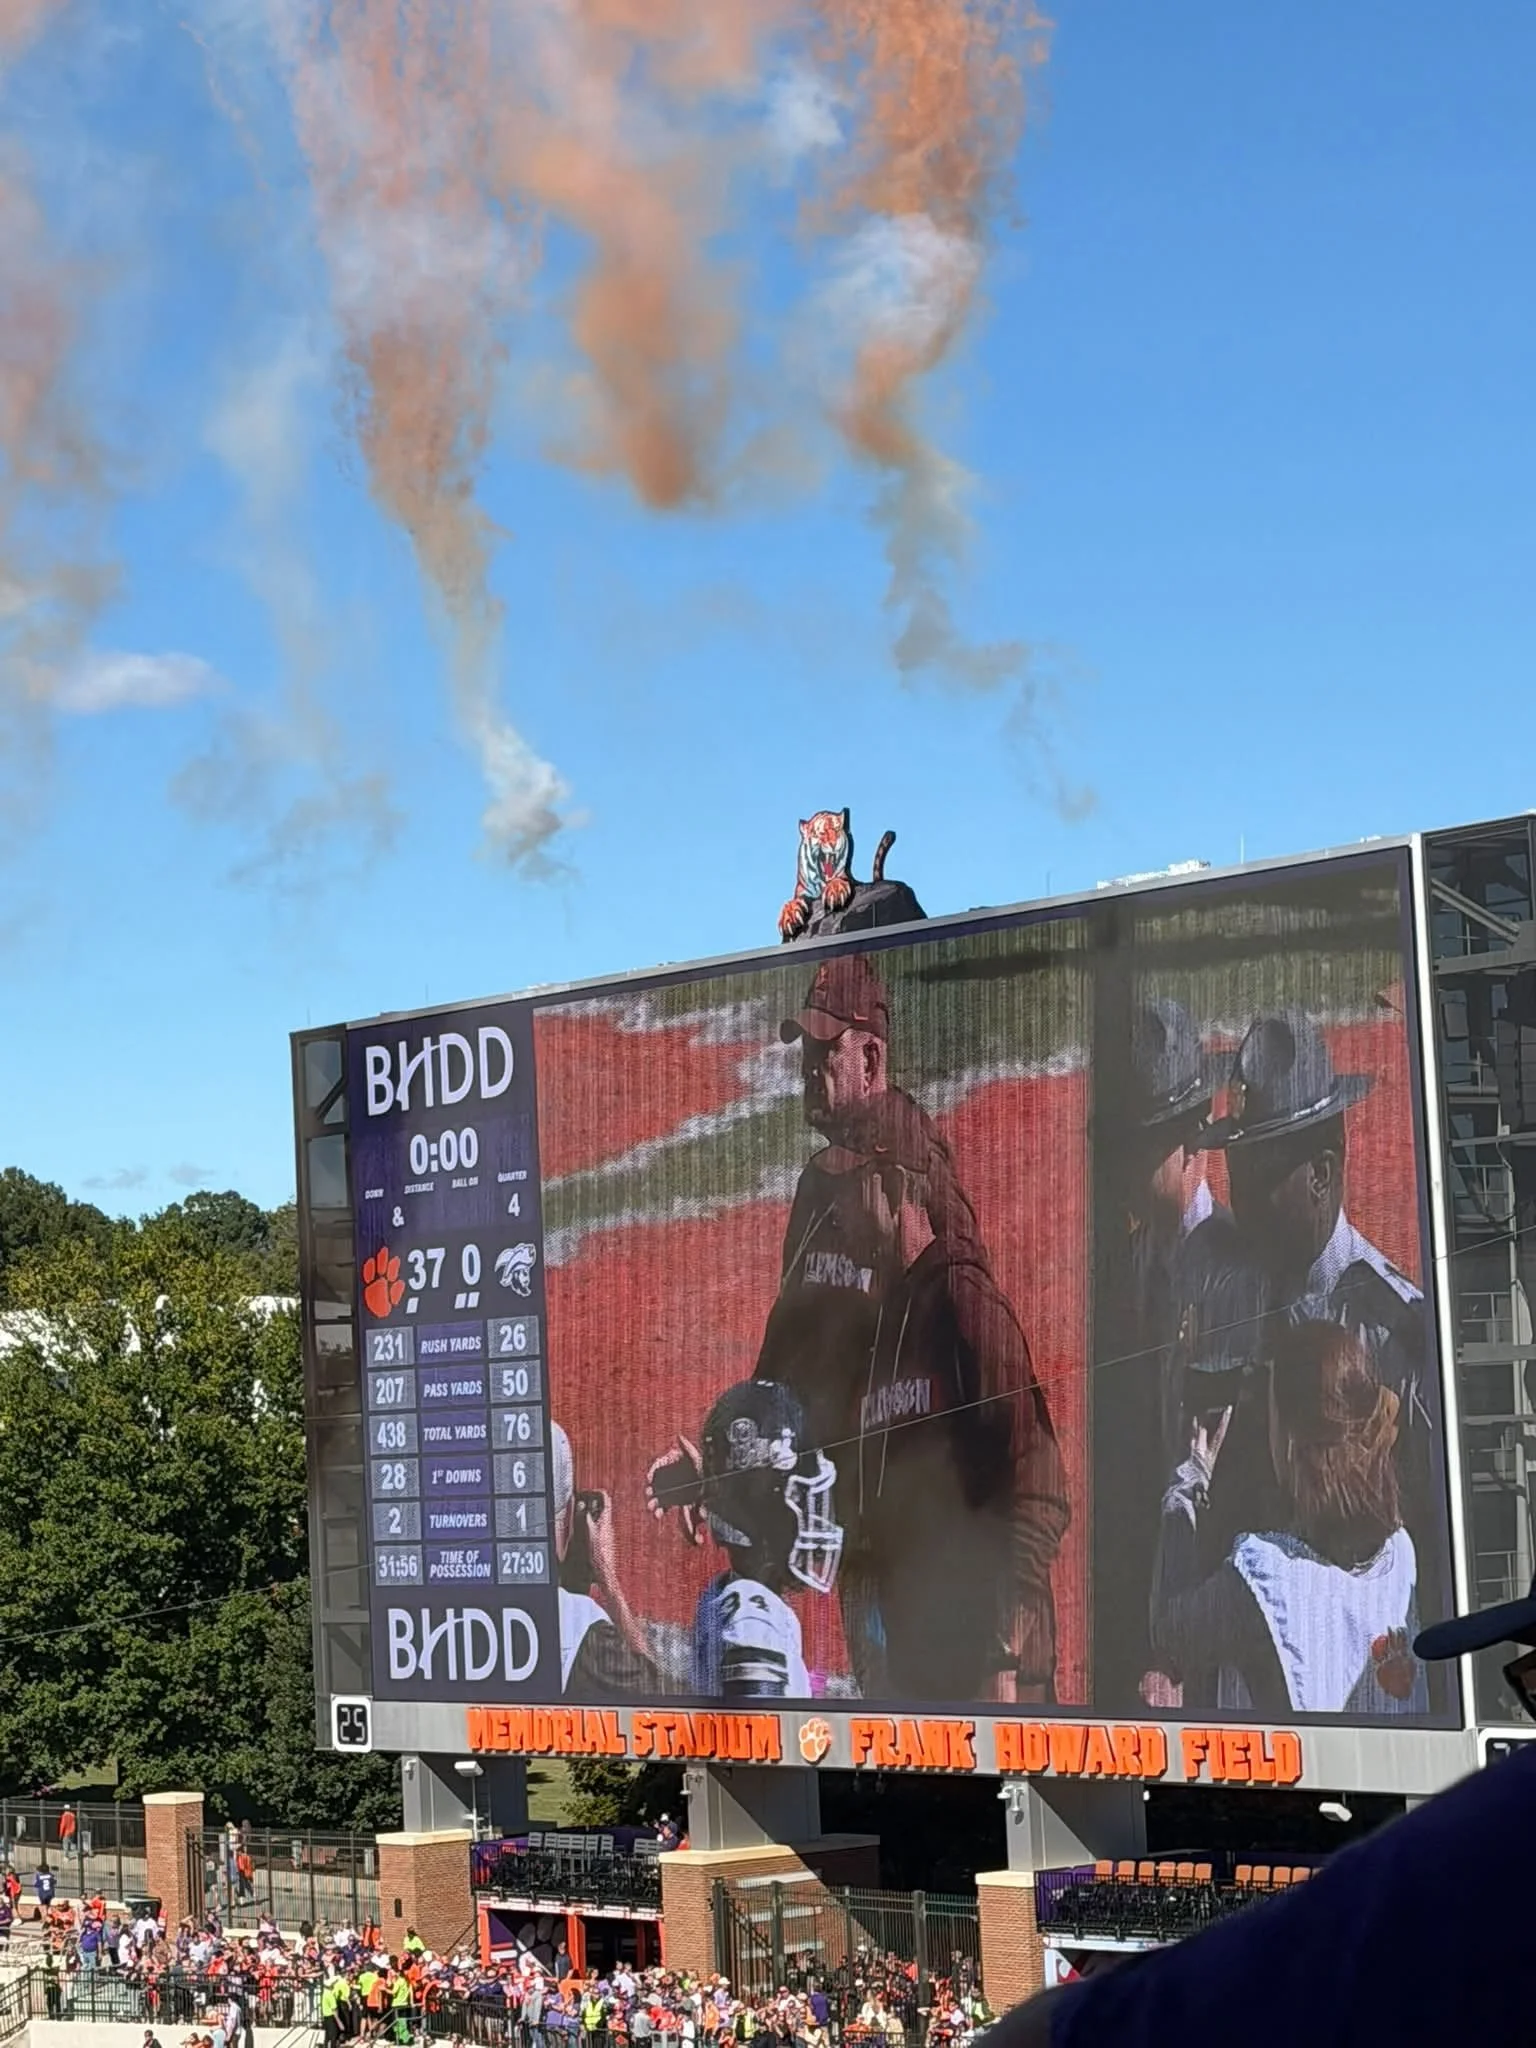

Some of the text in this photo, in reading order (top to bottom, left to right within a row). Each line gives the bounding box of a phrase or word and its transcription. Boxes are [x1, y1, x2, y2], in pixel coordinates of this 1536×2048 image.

[410, 1127, 479, 1175] 0:00
[404, 1182, 434, 1194] DISTANCE
[452, 1178, 467, 1188] BALL
[497, 1170, 527, 1183] QUARTER
[392, 1206, 404, 1227] &
[508, 1193, 520, 1216] 4
[407, 1248, 445, 1290] 37
[461, 1244, 481, 1285] 0
[374, 1334, 404, 1361] 231
[421, 1336, 481, 1354] RUSH YARDS
[500, 1324, 527, 1352] 26
[376, 1377, 404, 1404] 207
[424, 1381, 482, 1398] PASS YARDS
[502, 1369, 528, 1396] 50
[377, 1421, 406, 1448] 438
[424, 1424, 486, 1441] TOTAL YARDS
[503, 1413, 530, 1441] 76
[381, 1463, 406, 1490] 28
[446, 1469, 481, 1484] DOWNS
[513, 1461, 526, 1488] 6
[388, 1507, 401, 1533] 2
[429, 1513, 487, 1528] TURNOVERS
[516, 1503, 526, 1531] 1
[379, 1554, 417, 1578] 31:56
[440, 1550, 480, 1564] TIME OF
[502, 1551, 544, 1574] 27:30
[430, 1563, 491, 1578] POSSESSION
[340, 1707, 365, 1742] 25
[467, 1706, 782, 1760] MEMORIAL STADIUM
[849, 1717, 1302, 1784] FRANK HOWARD FIELD
